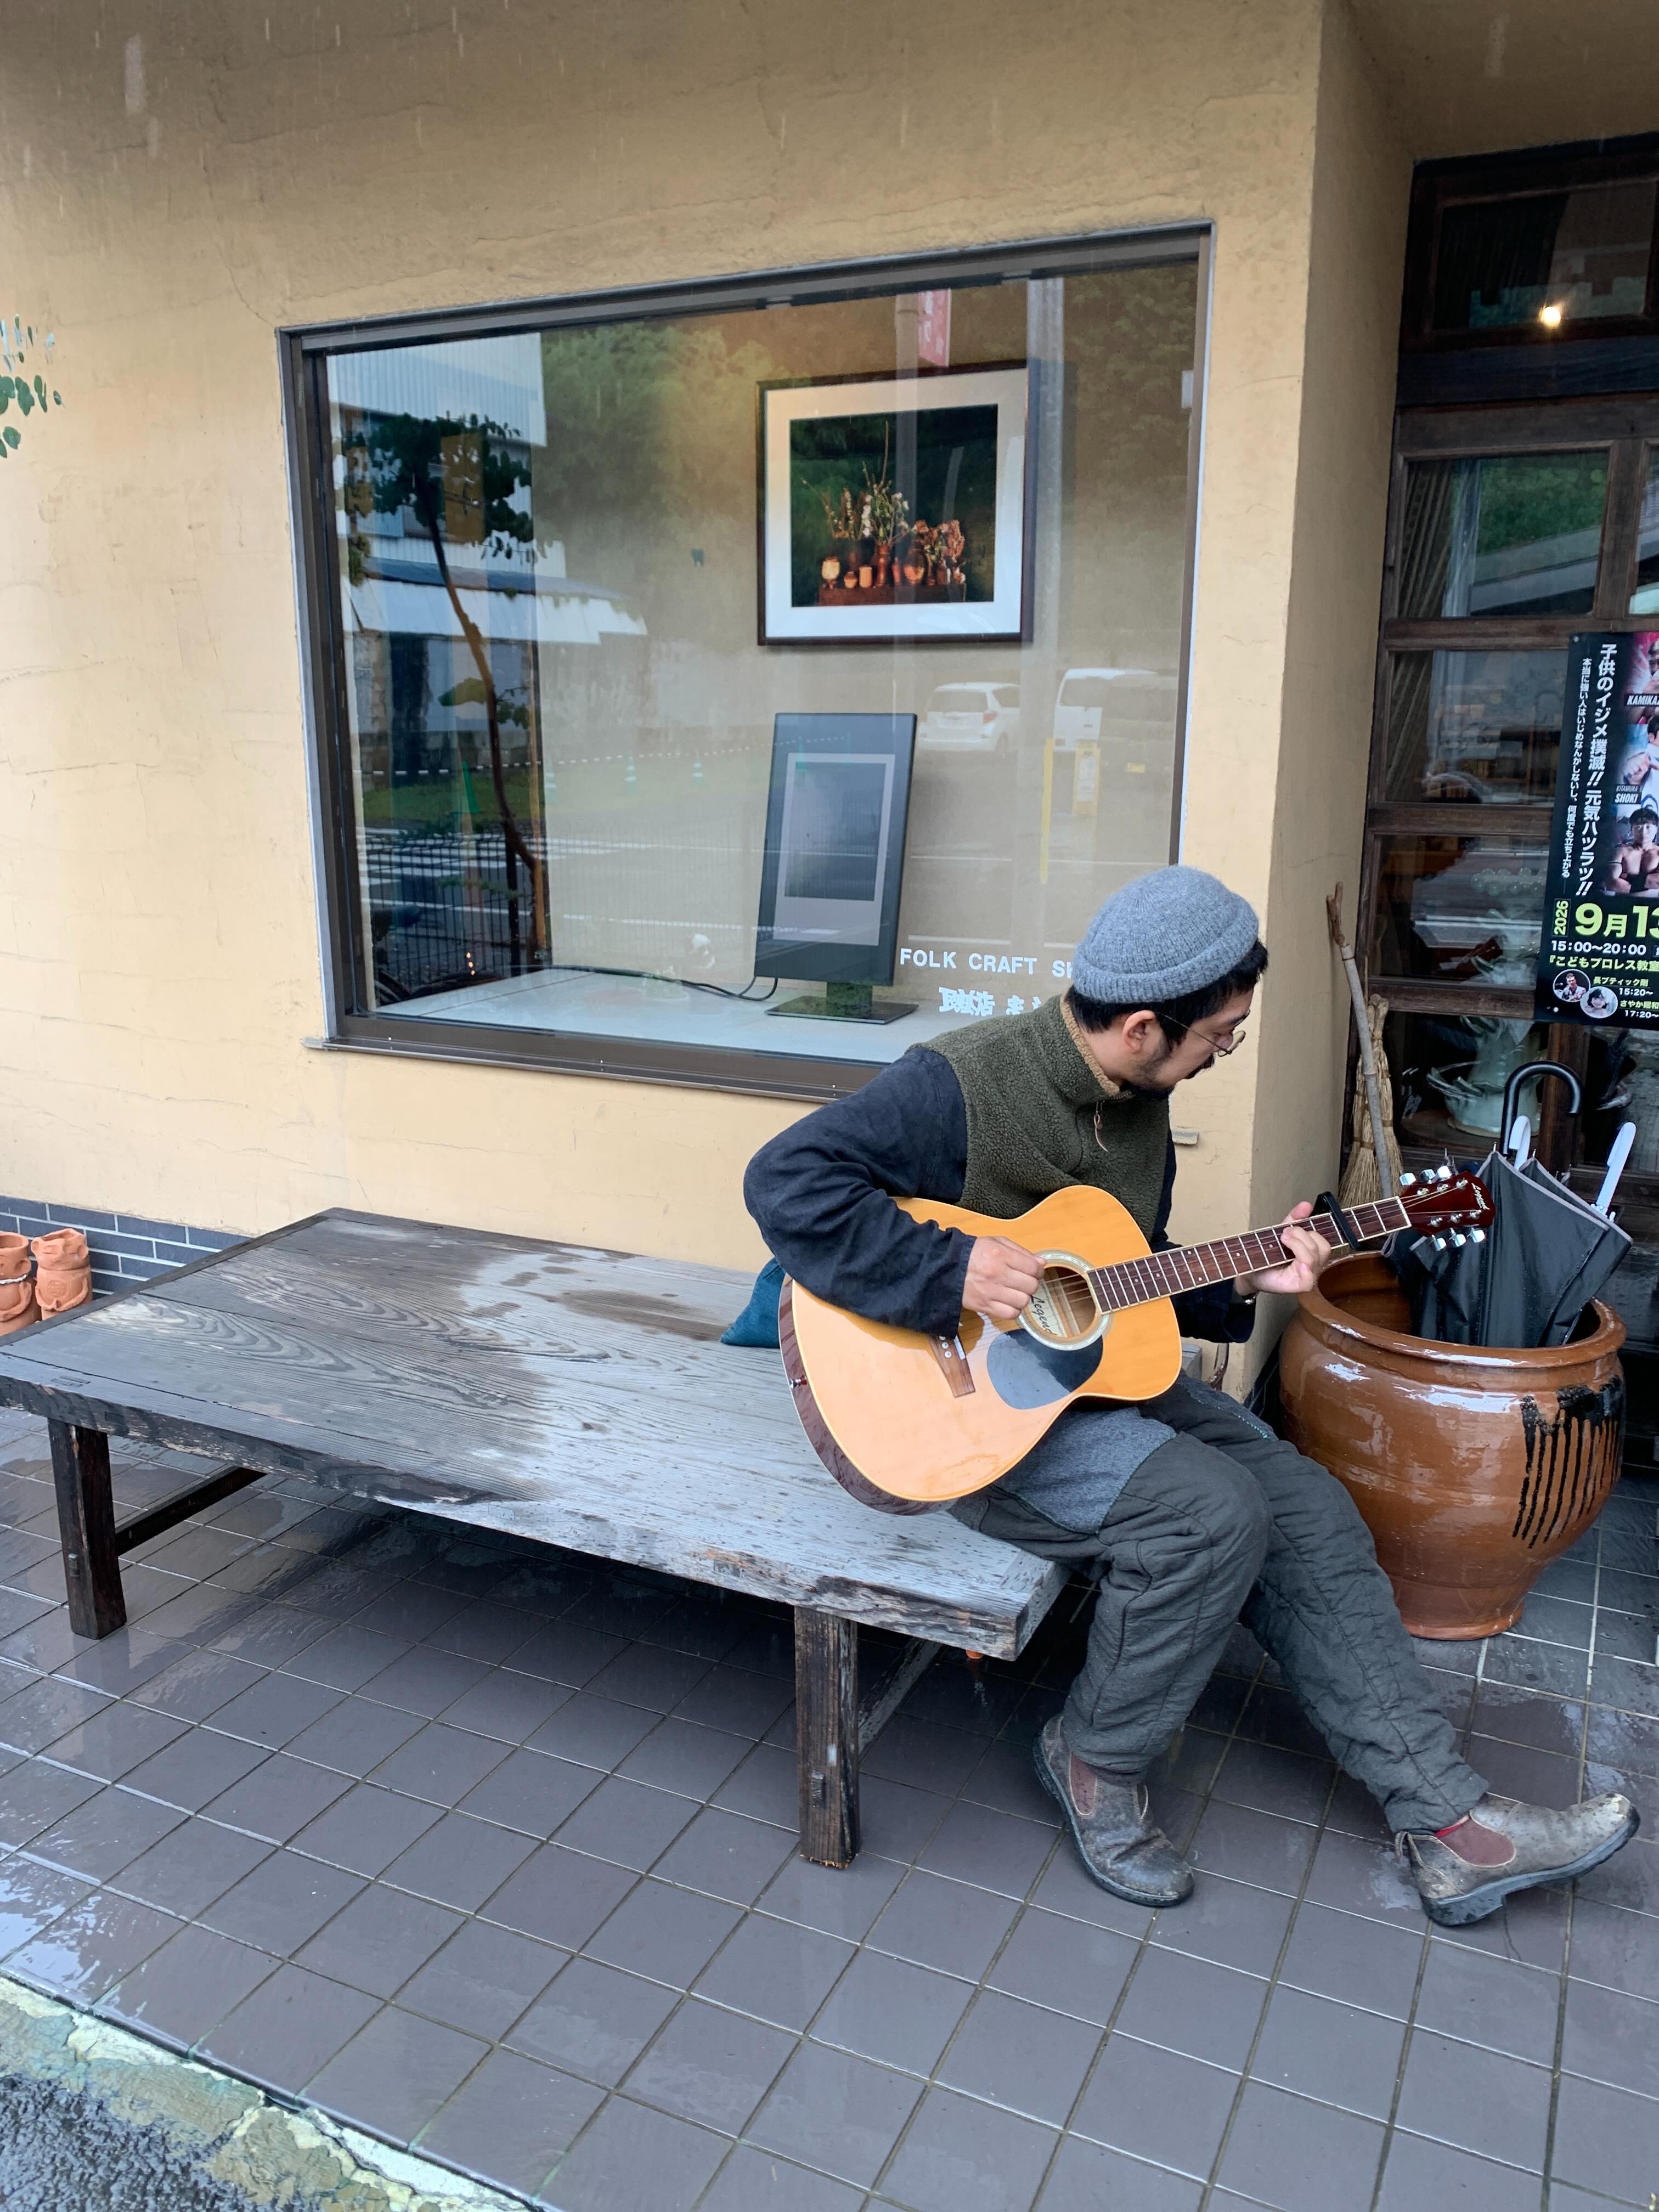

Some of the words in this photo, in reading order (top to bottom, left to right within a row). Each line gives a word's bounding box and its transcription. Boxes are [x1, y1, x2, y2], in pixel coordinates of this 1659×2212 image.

[1615, 793, 1639, 804] SHOKI
[1554, 900, 1569, 935] 2026
[900, 948, 957, 969] FOLK
[969, 953, 1037, 975] CRAFT
